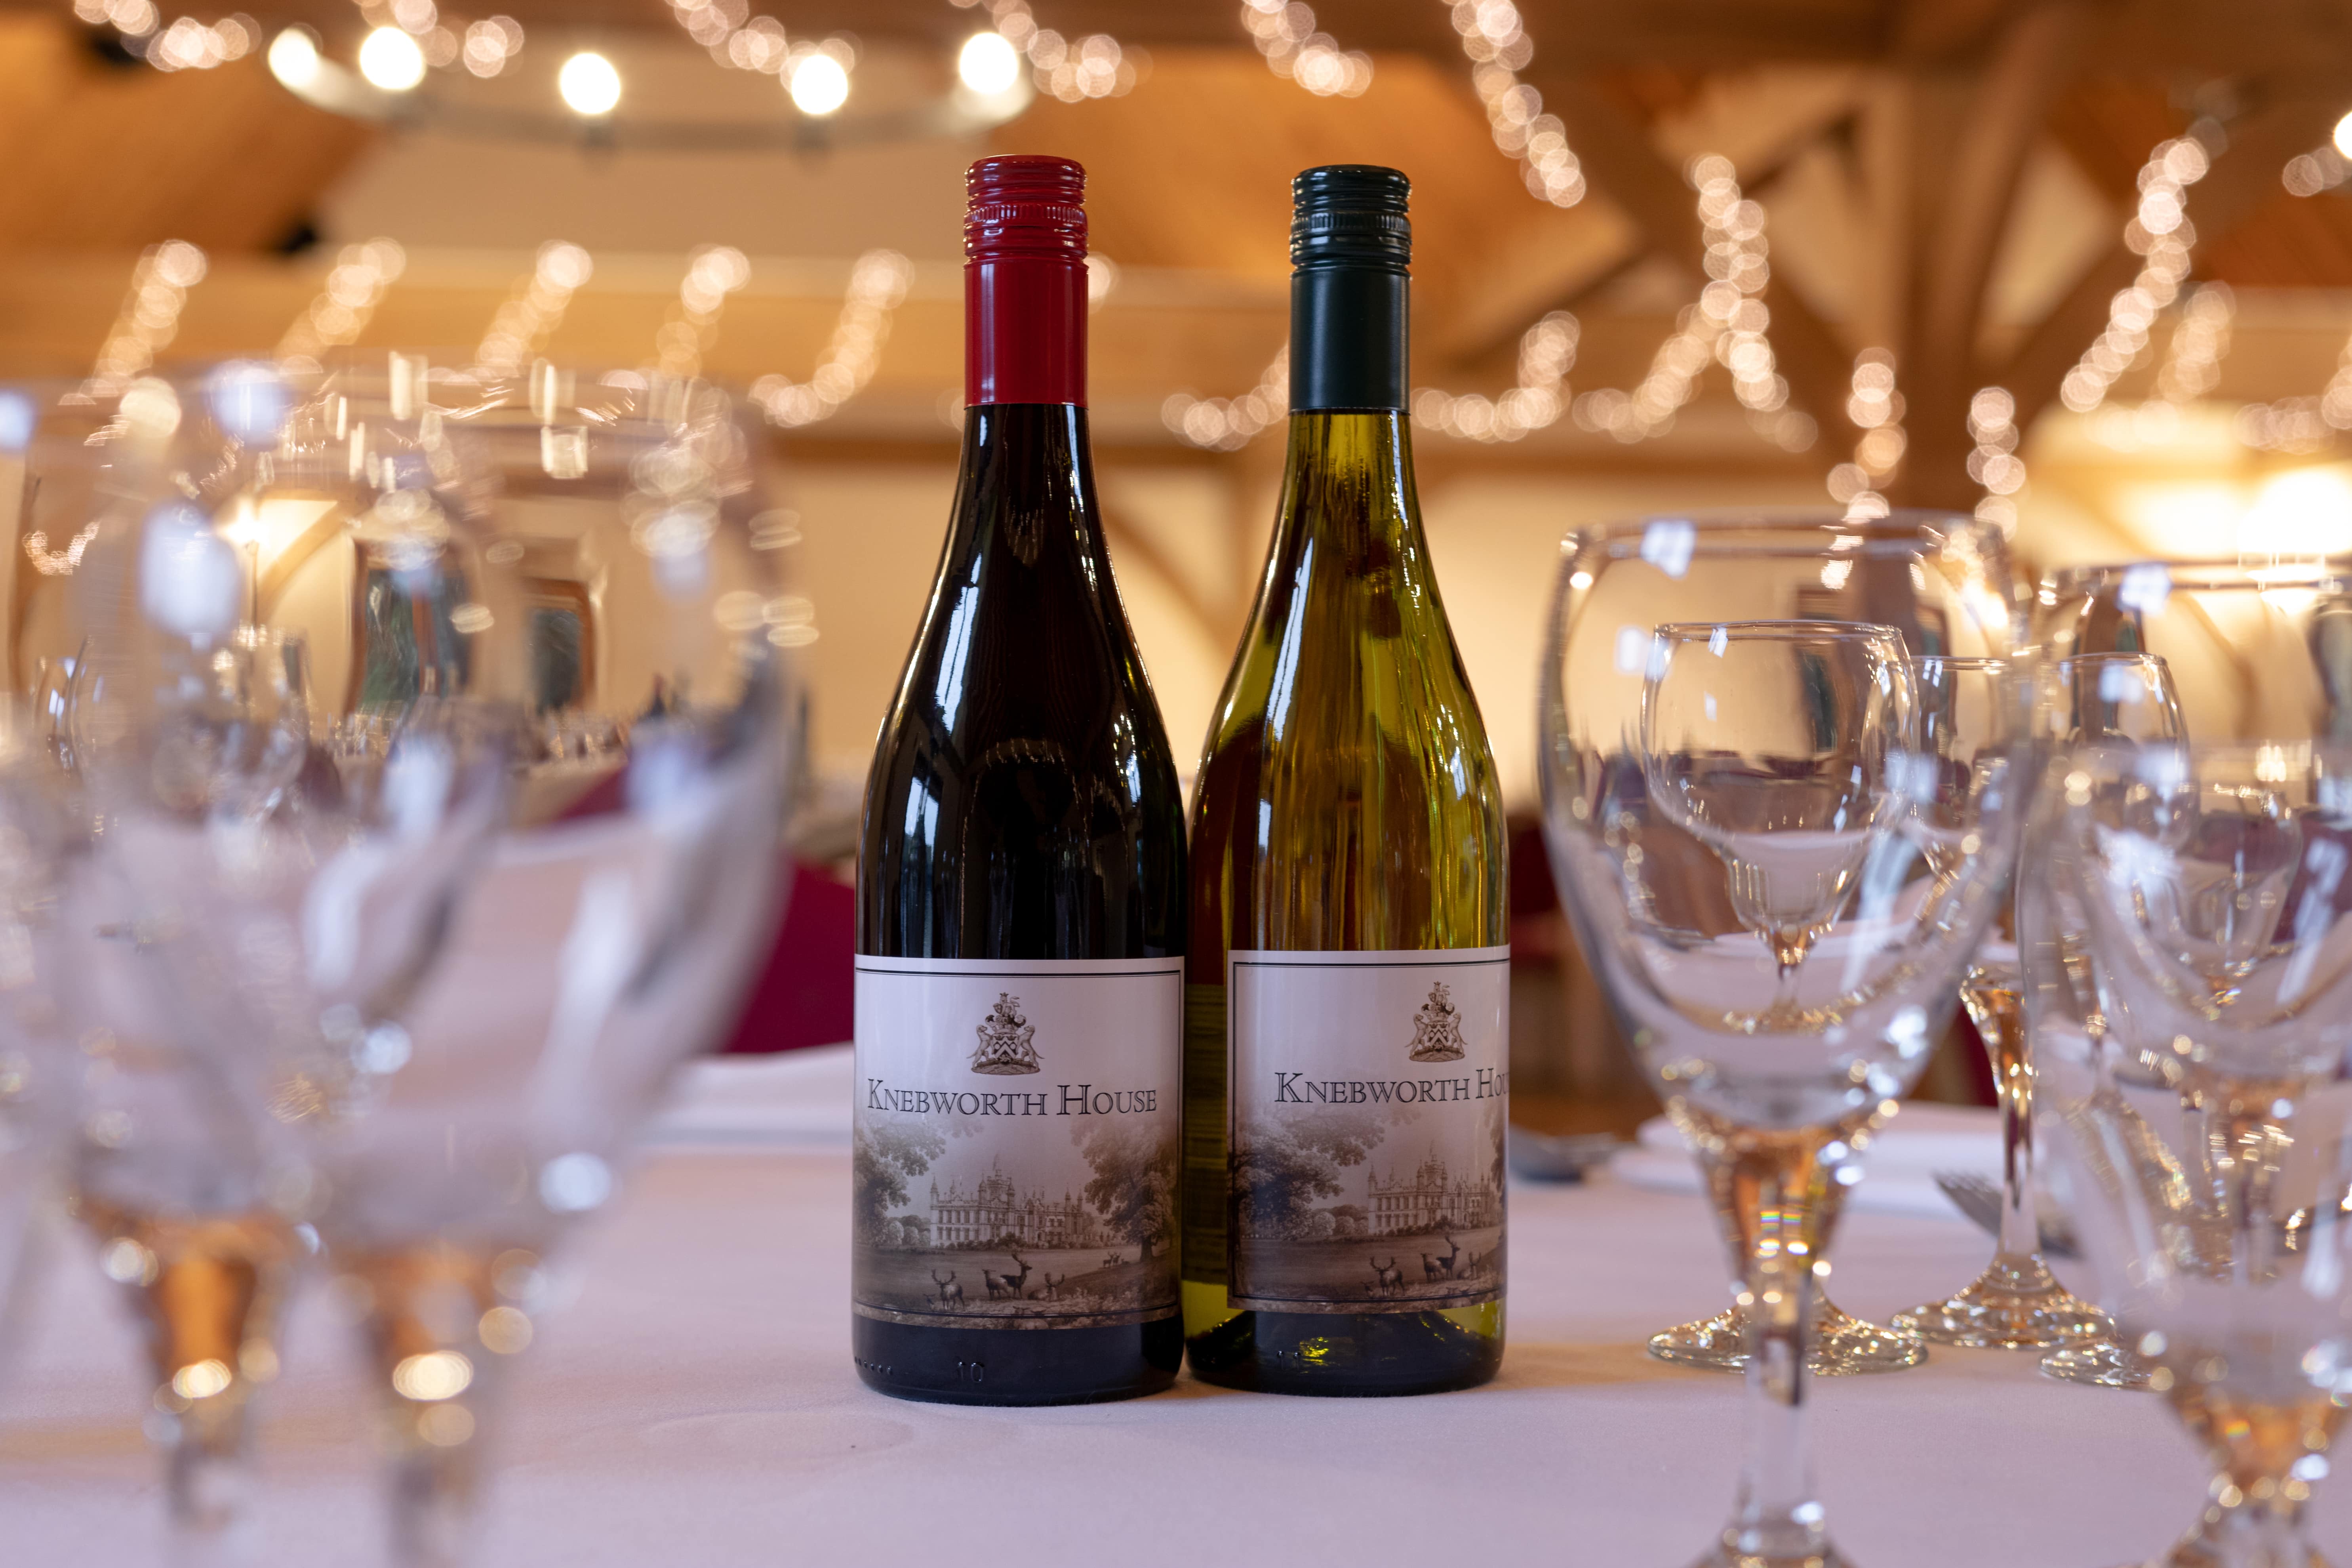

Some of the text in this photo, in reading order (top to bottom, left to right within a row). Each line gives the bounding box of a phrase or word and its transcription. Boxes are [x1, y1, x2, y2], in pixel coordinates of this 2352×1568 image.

[868, 1078, 1157, 1116] KNEBWORTH HOUSE
[1275, 1073, 1470, 1103] KNEBWORTH
